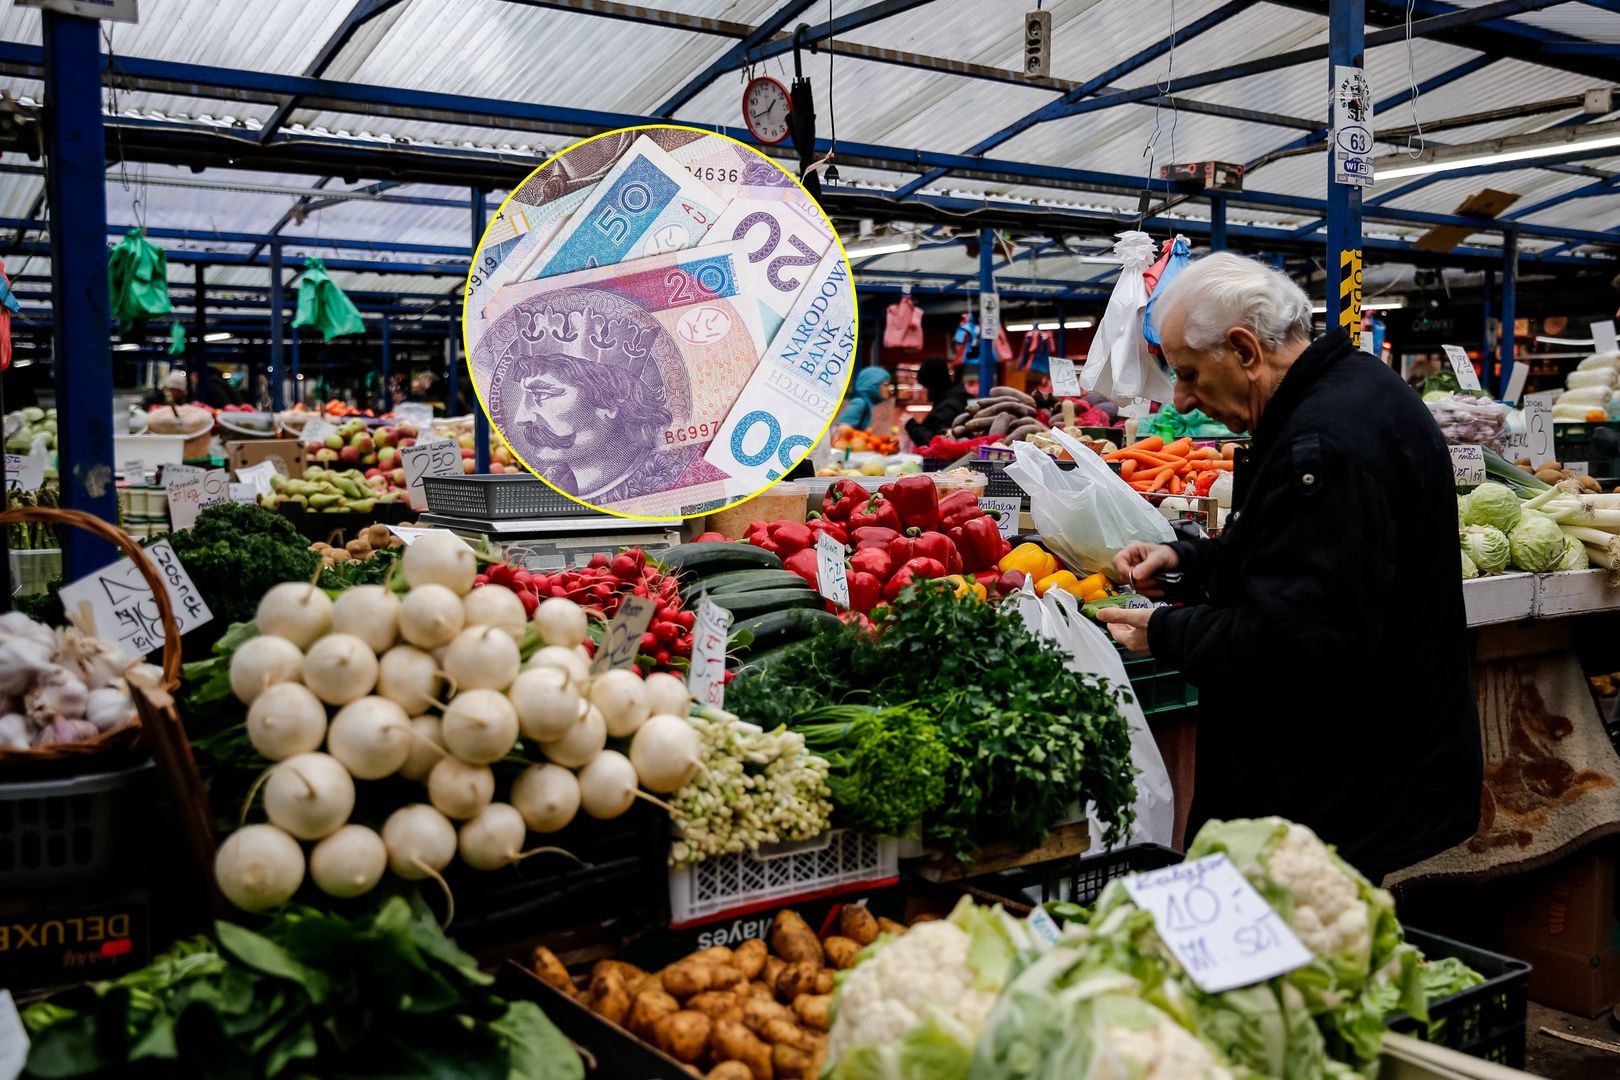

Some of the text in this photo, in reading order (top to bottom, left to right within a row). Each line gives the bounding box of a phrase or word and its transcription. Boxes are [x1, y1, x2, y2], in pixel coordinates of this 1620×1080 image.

[1350, 133, 1366, 152] 63
[593, 180, 654, 246] 50
[664, 261, 729, 306] 20
[800, 319, 841, 376] BANK
[665, 420, 719, 445] BG997
[1531, 414, 1547, 455] 3
[412, 452, 456, 488] 2 50
[152, 544, 202, 619] Czosnek
